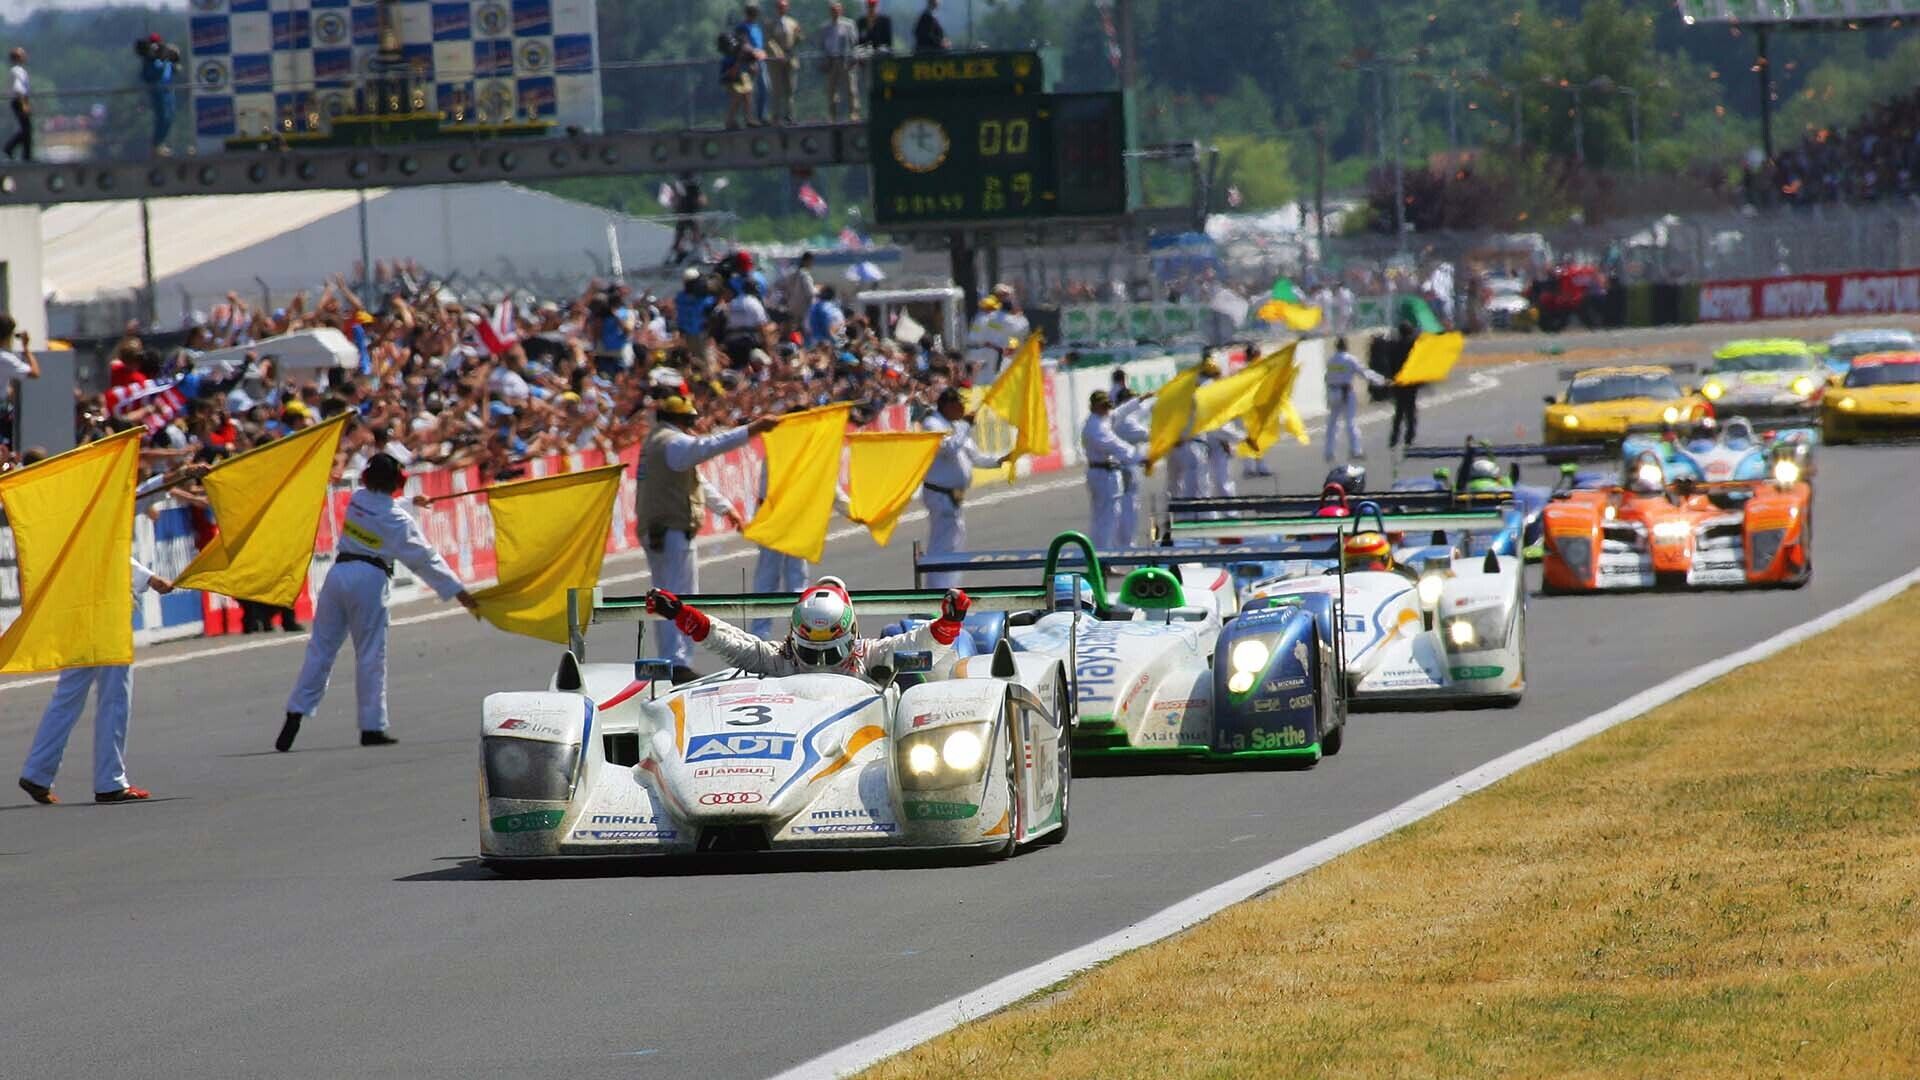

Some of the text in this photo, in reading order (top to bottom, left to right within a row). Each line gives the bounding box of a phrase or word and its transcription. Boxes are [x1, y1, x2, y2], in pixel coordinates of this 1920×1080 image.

[912, 58, 999, 81] ROLEX
[726, 705, 773, 727] 3
[532, 720, 562, 735] line
[1218, 725, 1305, 749] La Sarthe
[687, 736, 796, 760] ADT
[716, 766, 770, 775] ANSUL
[592, 815, 659, 824] MAHLE
[811, 808, 880, 819] MAHLE
[817, 823, 891, 832] MICHELIN
[600, 830, 672, 839] MICHELIN
